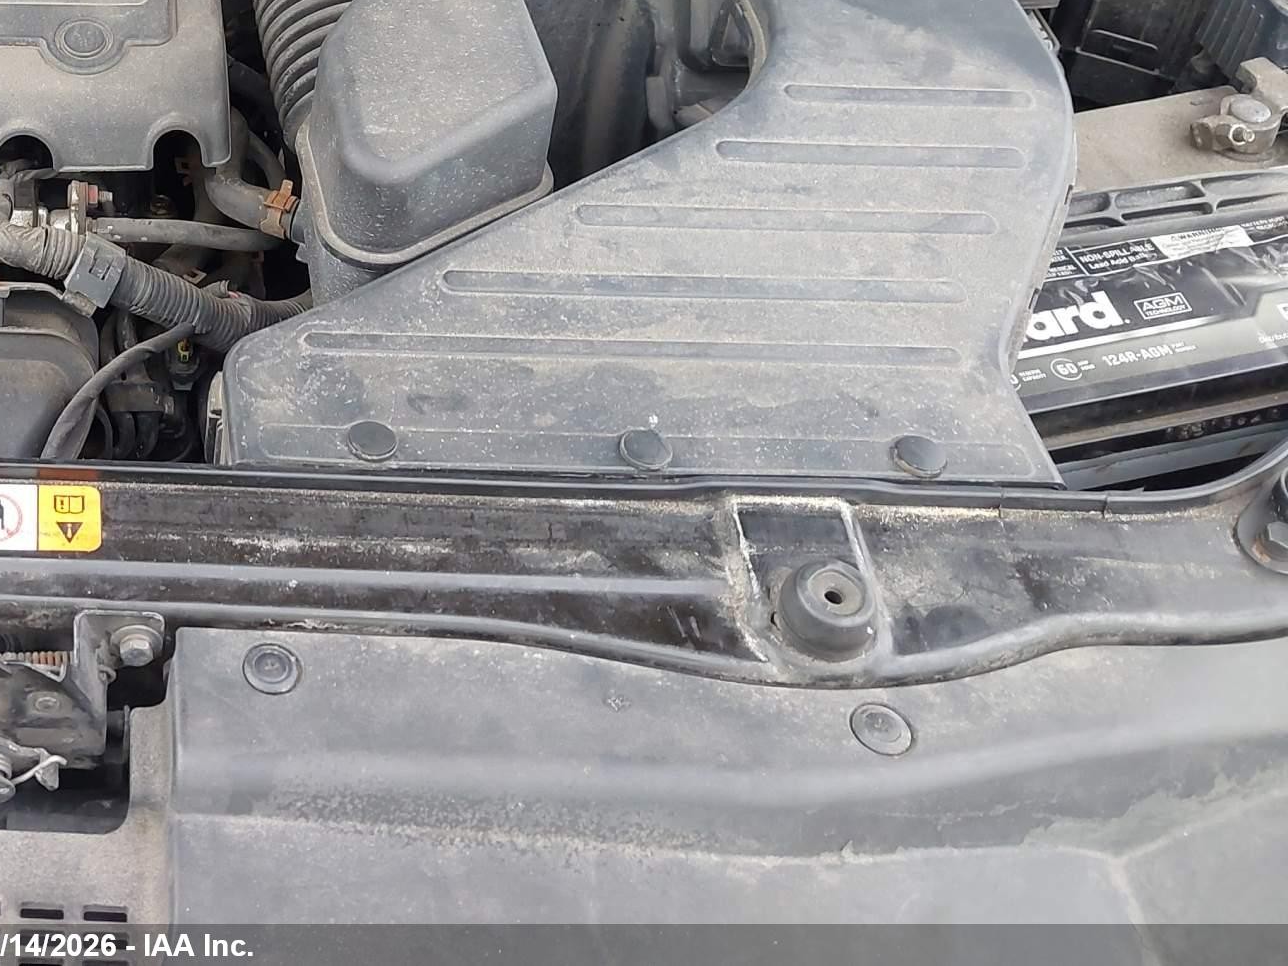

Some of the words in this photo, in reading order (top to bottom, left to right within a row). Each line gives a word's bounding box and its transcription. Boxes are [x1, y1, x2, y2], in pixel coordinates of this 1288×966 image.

[1079, 240, 1155, 263] NON-SPILLABLE
[1088, 260, 1110, 270] Lead
[1143, 295, 1184, 311] AGM
[1145, 304, 1186, 316] TECHNOLOGY
[1023, 290, 1130, 341] ard.
[1102, 344, 1174, 366] 124R-AGM
[1056, 362, 1078, 375] 60
